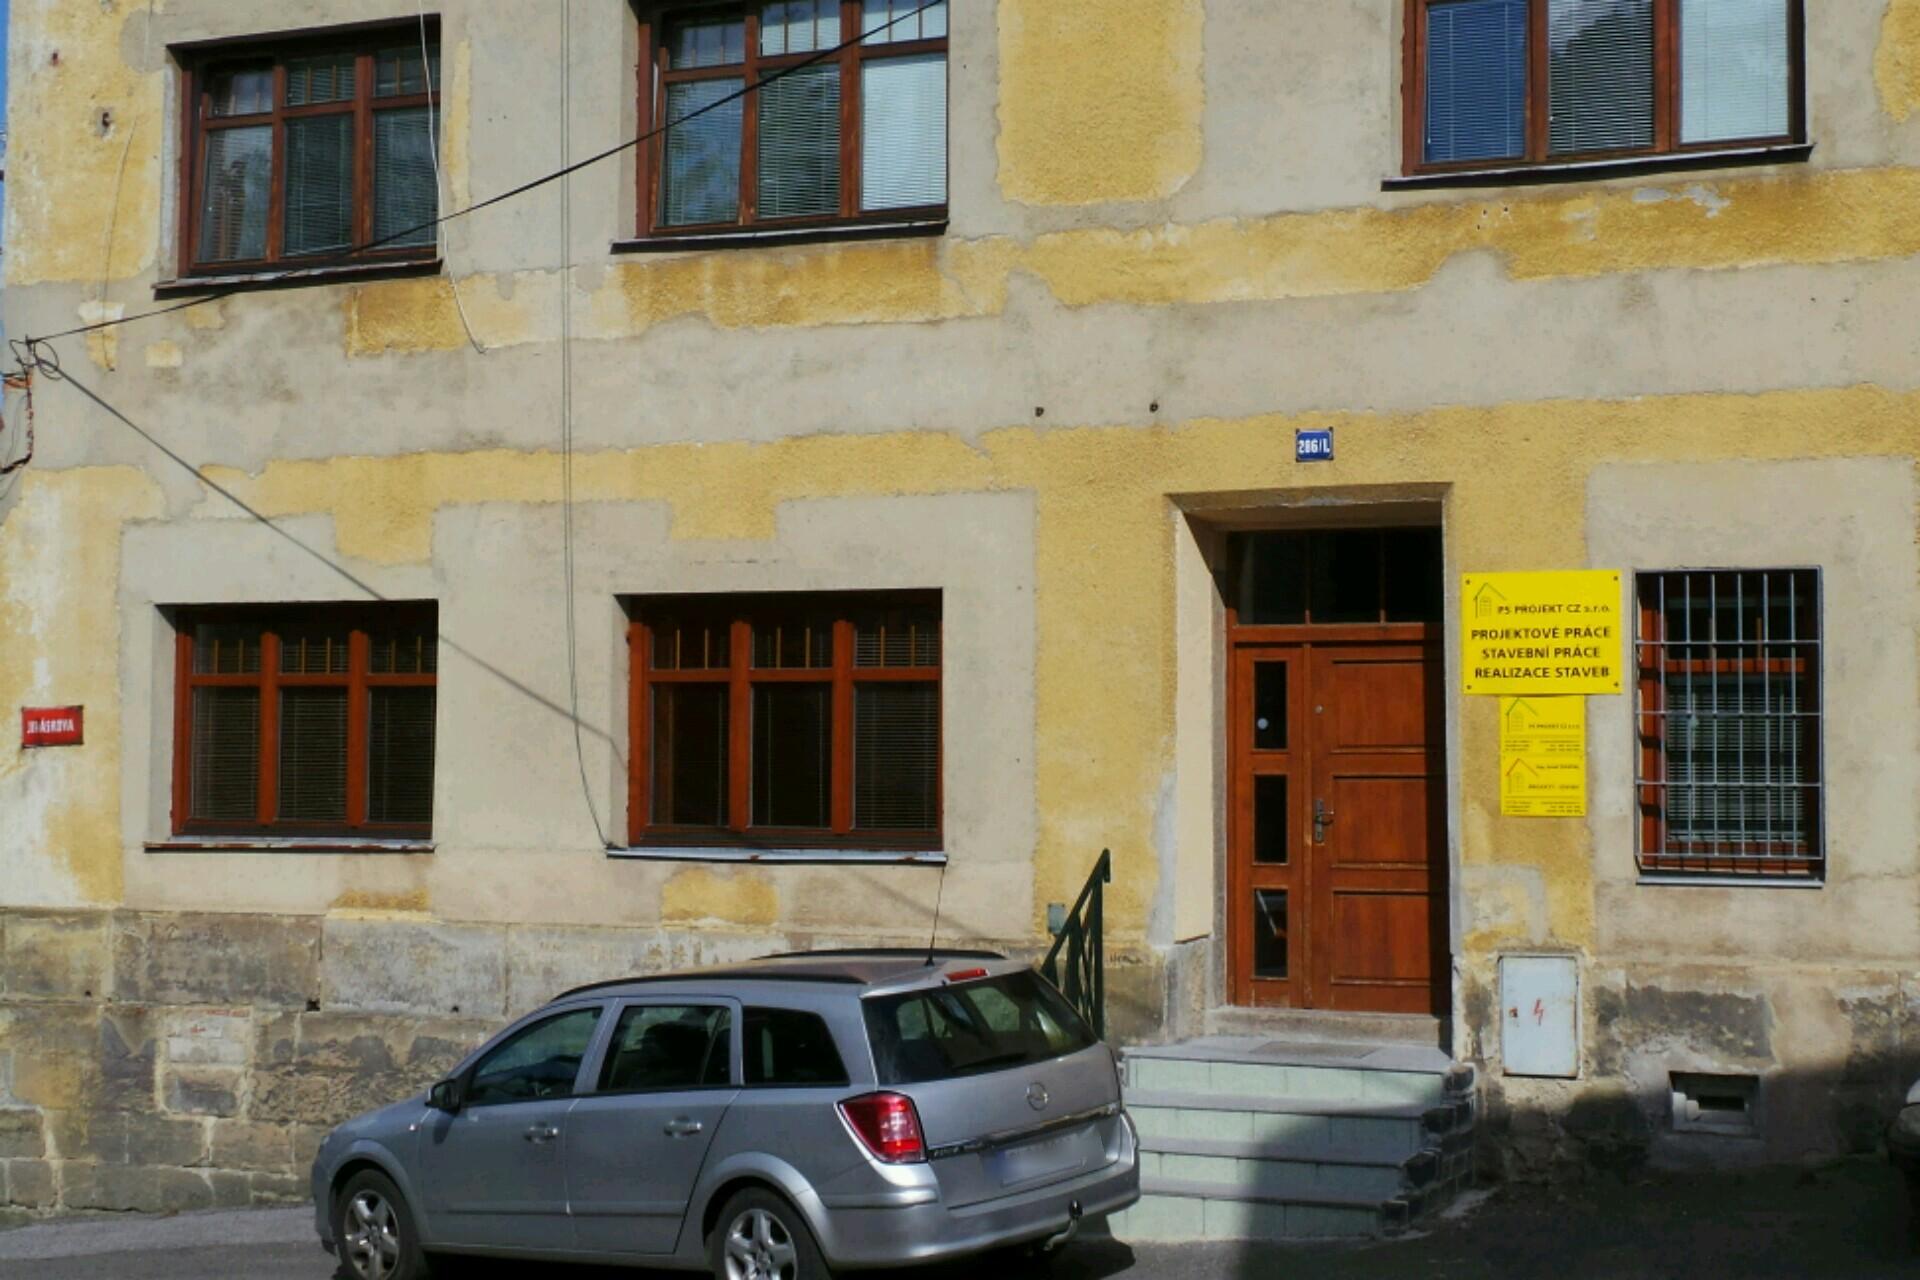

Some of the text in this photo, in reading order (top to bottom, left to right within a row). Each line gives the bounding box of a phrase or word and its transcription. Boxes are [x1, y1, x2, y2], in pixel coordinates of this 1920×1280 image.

[1514, 604, 1563, 614] PROJEKT
[1566, 603, 1581, 613] CZ
[1471, 624, 1611, 640] PROJEKTOVÉ PRÁCE
[1482, 644, 1600, 660] STAVEBNÍ PRÁCE
[1475, 666, 1610, 679] REALIZACE STAVEB
